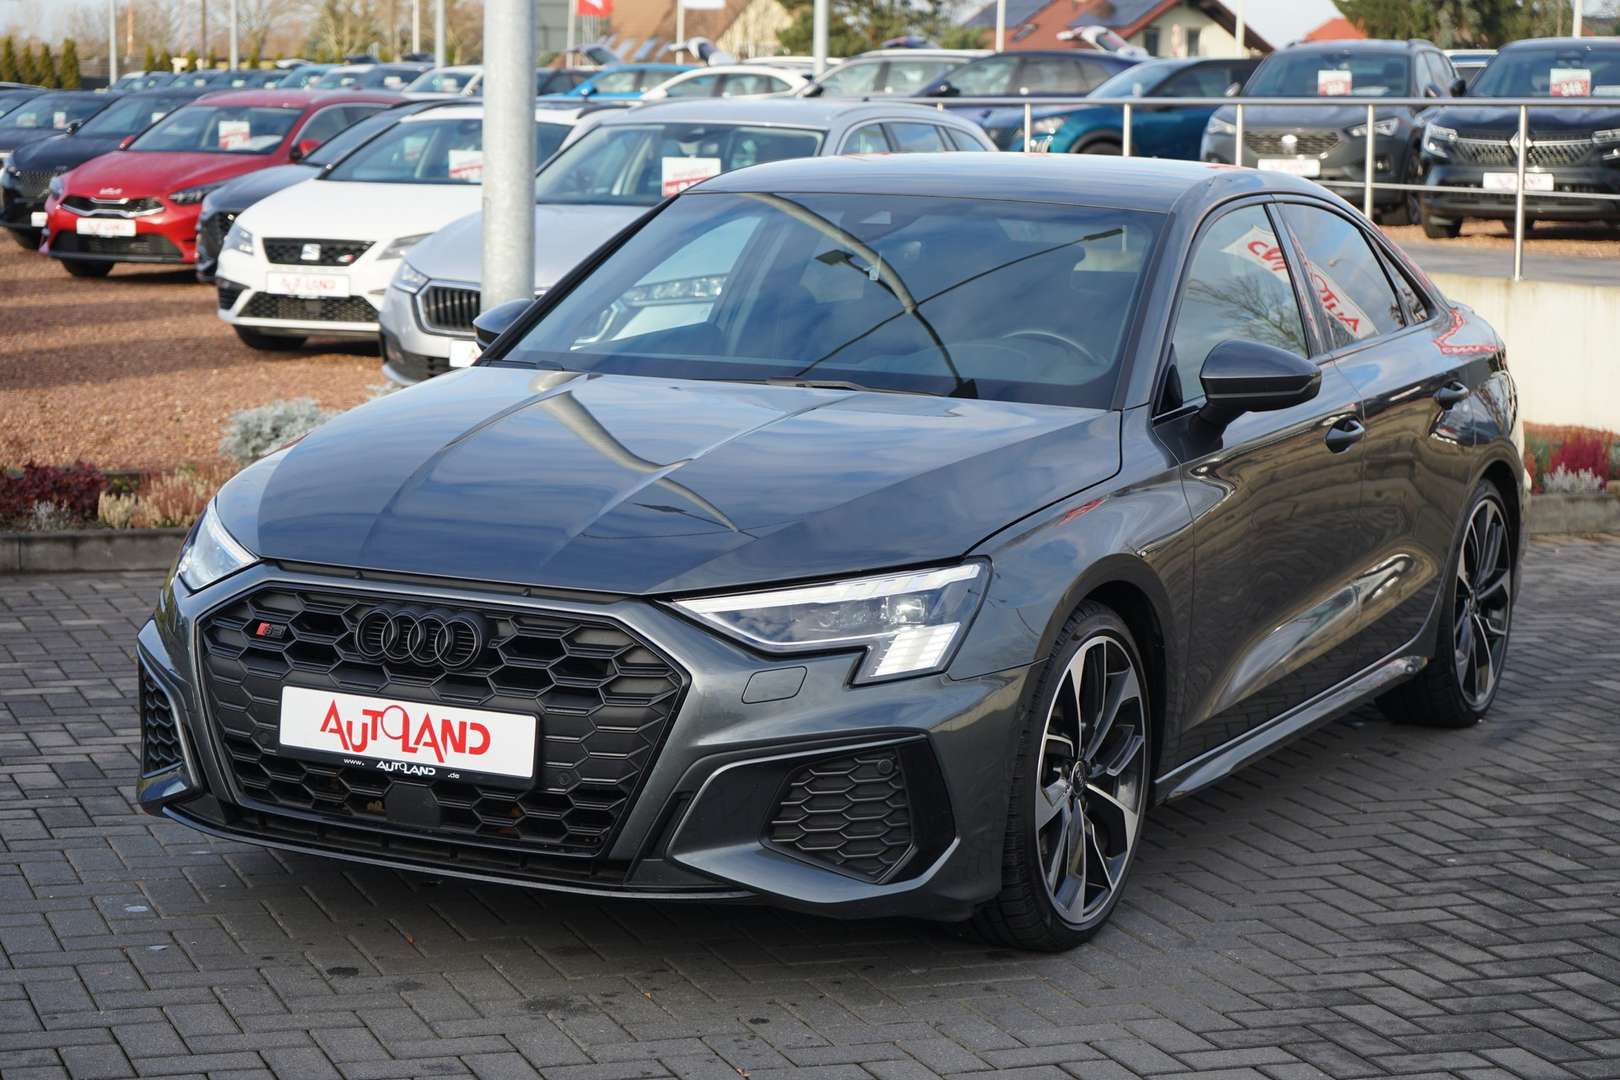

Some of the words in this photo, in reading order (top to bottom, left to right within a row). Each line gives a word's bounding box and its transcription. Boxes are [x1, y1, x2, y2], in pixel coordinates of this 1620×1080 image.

[320, 700, 491, 763] AUTOLAND
[344, 758, 365, 766] www.
[376, 760, 436, 776] AUTOLAND
[447, 771, 460, 779] .de
